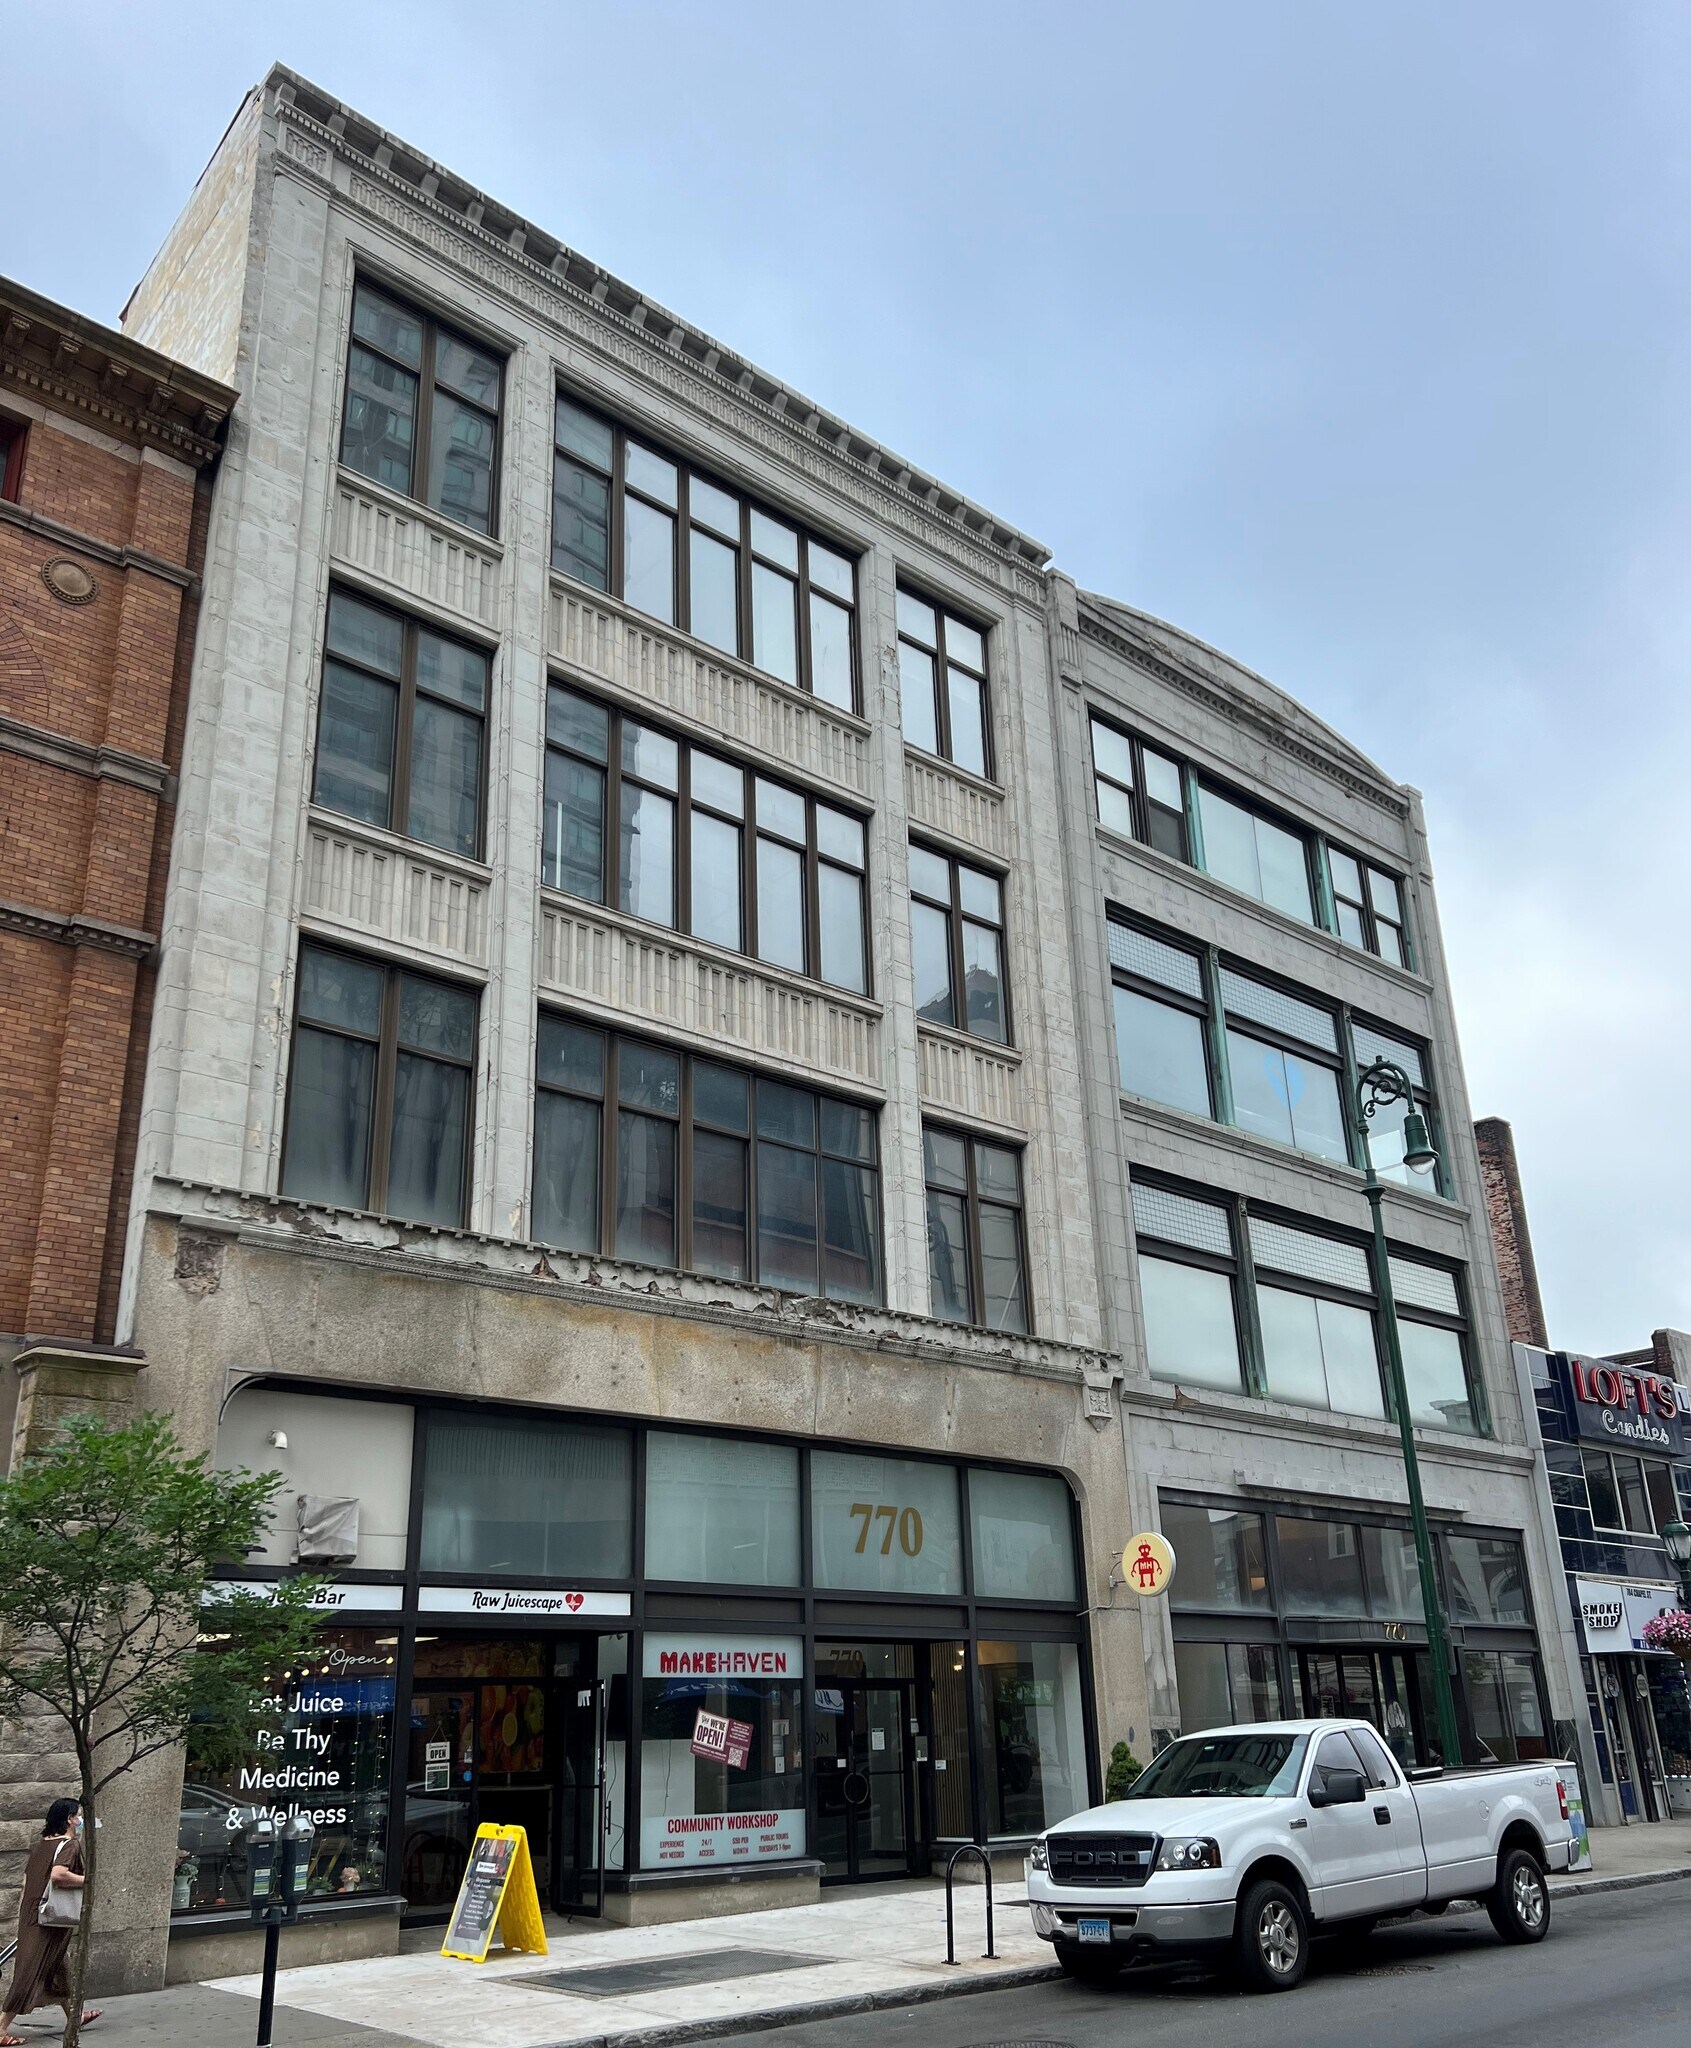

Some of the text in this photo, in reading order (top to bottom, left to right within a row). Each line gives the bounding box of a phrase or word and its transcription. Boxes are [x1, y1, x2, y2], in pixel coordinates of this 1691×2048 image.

[1572, 1360, 1677, 1419] LOFT'S
[1602, 1409, 1670, 1445] Candies
[850, 1503, 923, 1557] 770
[1140, 1561, 1152, 1570] MH
[472, 1591, 562, 1612] Raw Juicescape
[1582, 1603, 1619, 1616] SMOKE
[1384, 1622, 1406, 1640] 770
[1588, 1615, 1617, 1627] SHOP
[329, 1649, 386, 1675] Open
[660, 1651, 787, 1674] MAKEHAVEN
[289, 1692, 344, 1713] Juice
[257, 1728, 331, 1755] Be Thy
[696, 1725, 724, 1748] OPEN!
[430, 1749, 447, 1759] OPEN
[240, 1765, 340, 1790] Medicine
[226, 1807, 244, 1830] &
[668, 1813, 779, 1834] COMMUNITY WORKSHOP
[660, 1840, 684, 1848] EXPERIENCE
[702, 1838, 712, 1846] 24/7
[760, 1834, 775, 1842] PUBLIC
[699, 1849, 715, 1857] ACCESS
[1054, 1850, 1140, 1866] FORD
